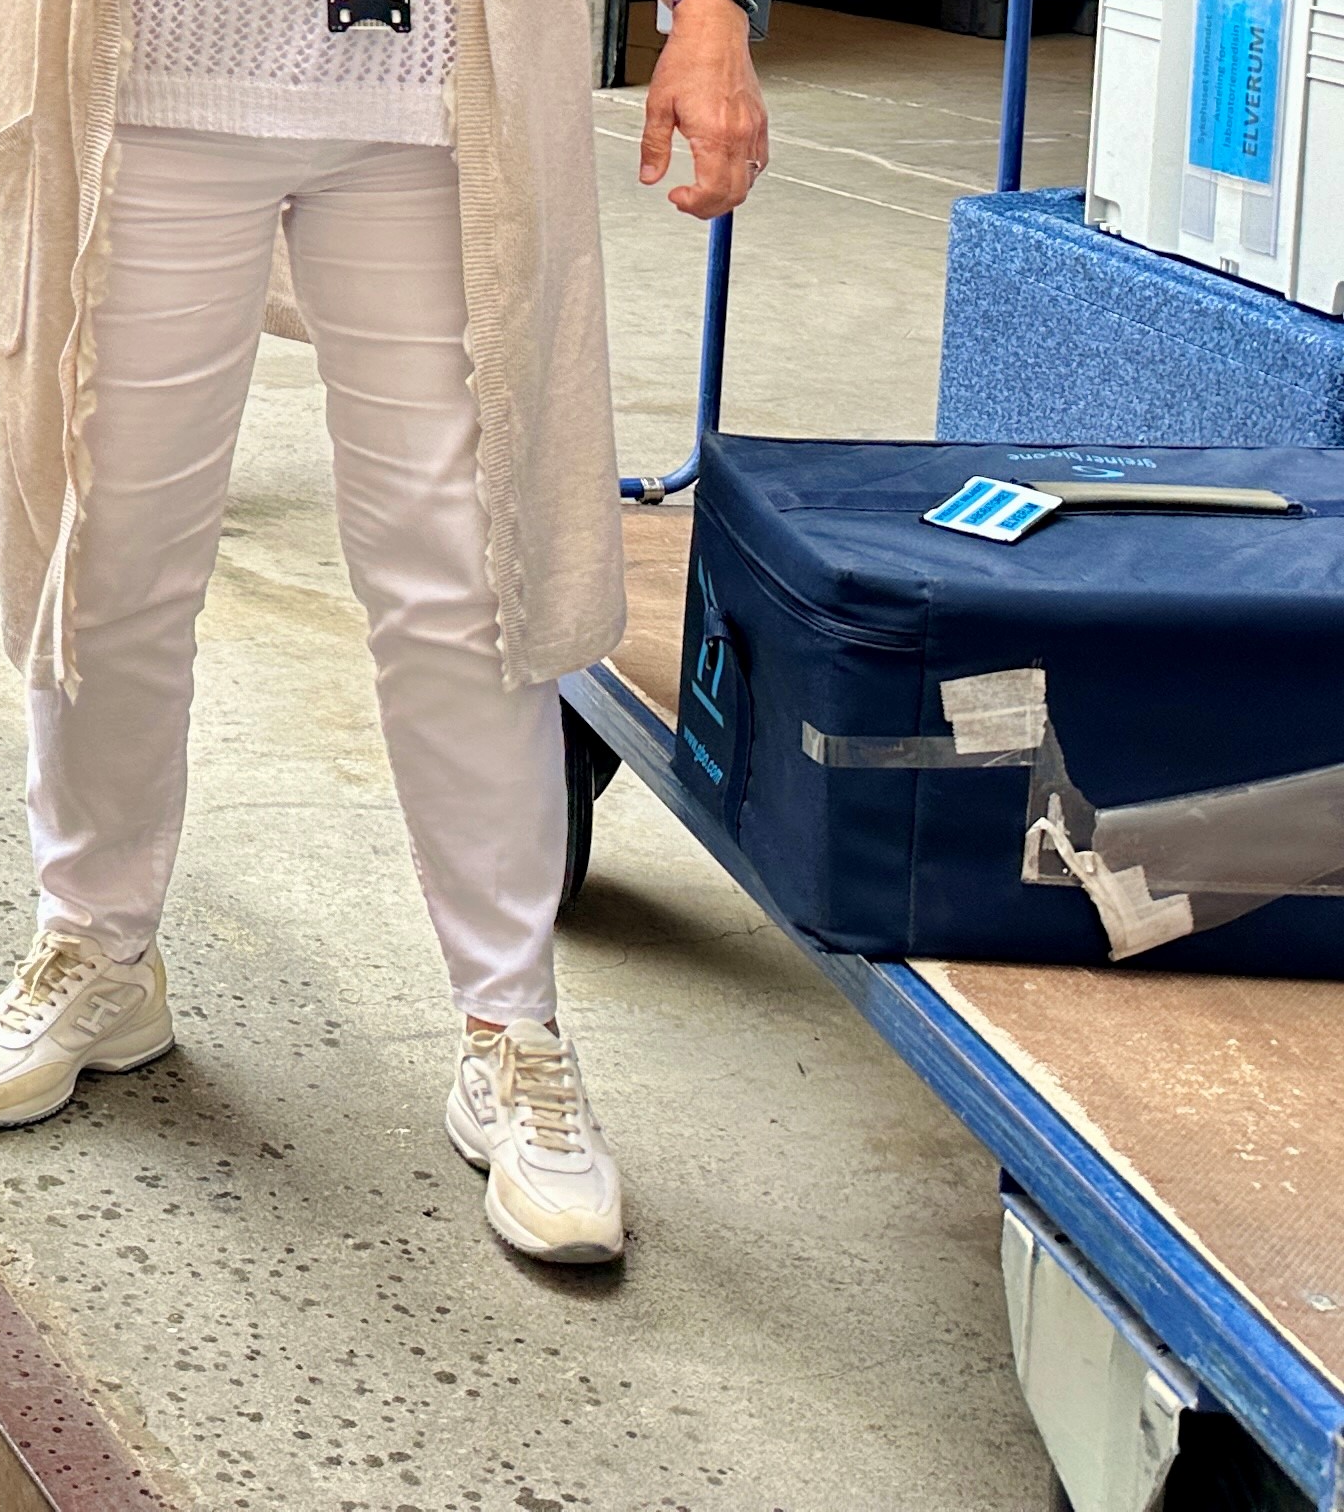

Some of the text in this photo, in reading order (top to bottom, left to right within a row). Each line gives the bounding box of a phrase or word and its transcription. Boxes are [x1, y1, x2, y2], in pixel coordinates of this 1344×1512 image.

[1216, 43, 1226, 63] for
[1197, 79, 1209, 144] Sykehuset
[1223, 24, 1240, 148] laboratoriemedisin
[1242, 26, 1265, 157] ELVERUM
[1007, 451, 1157, 469] greiner bio-one
